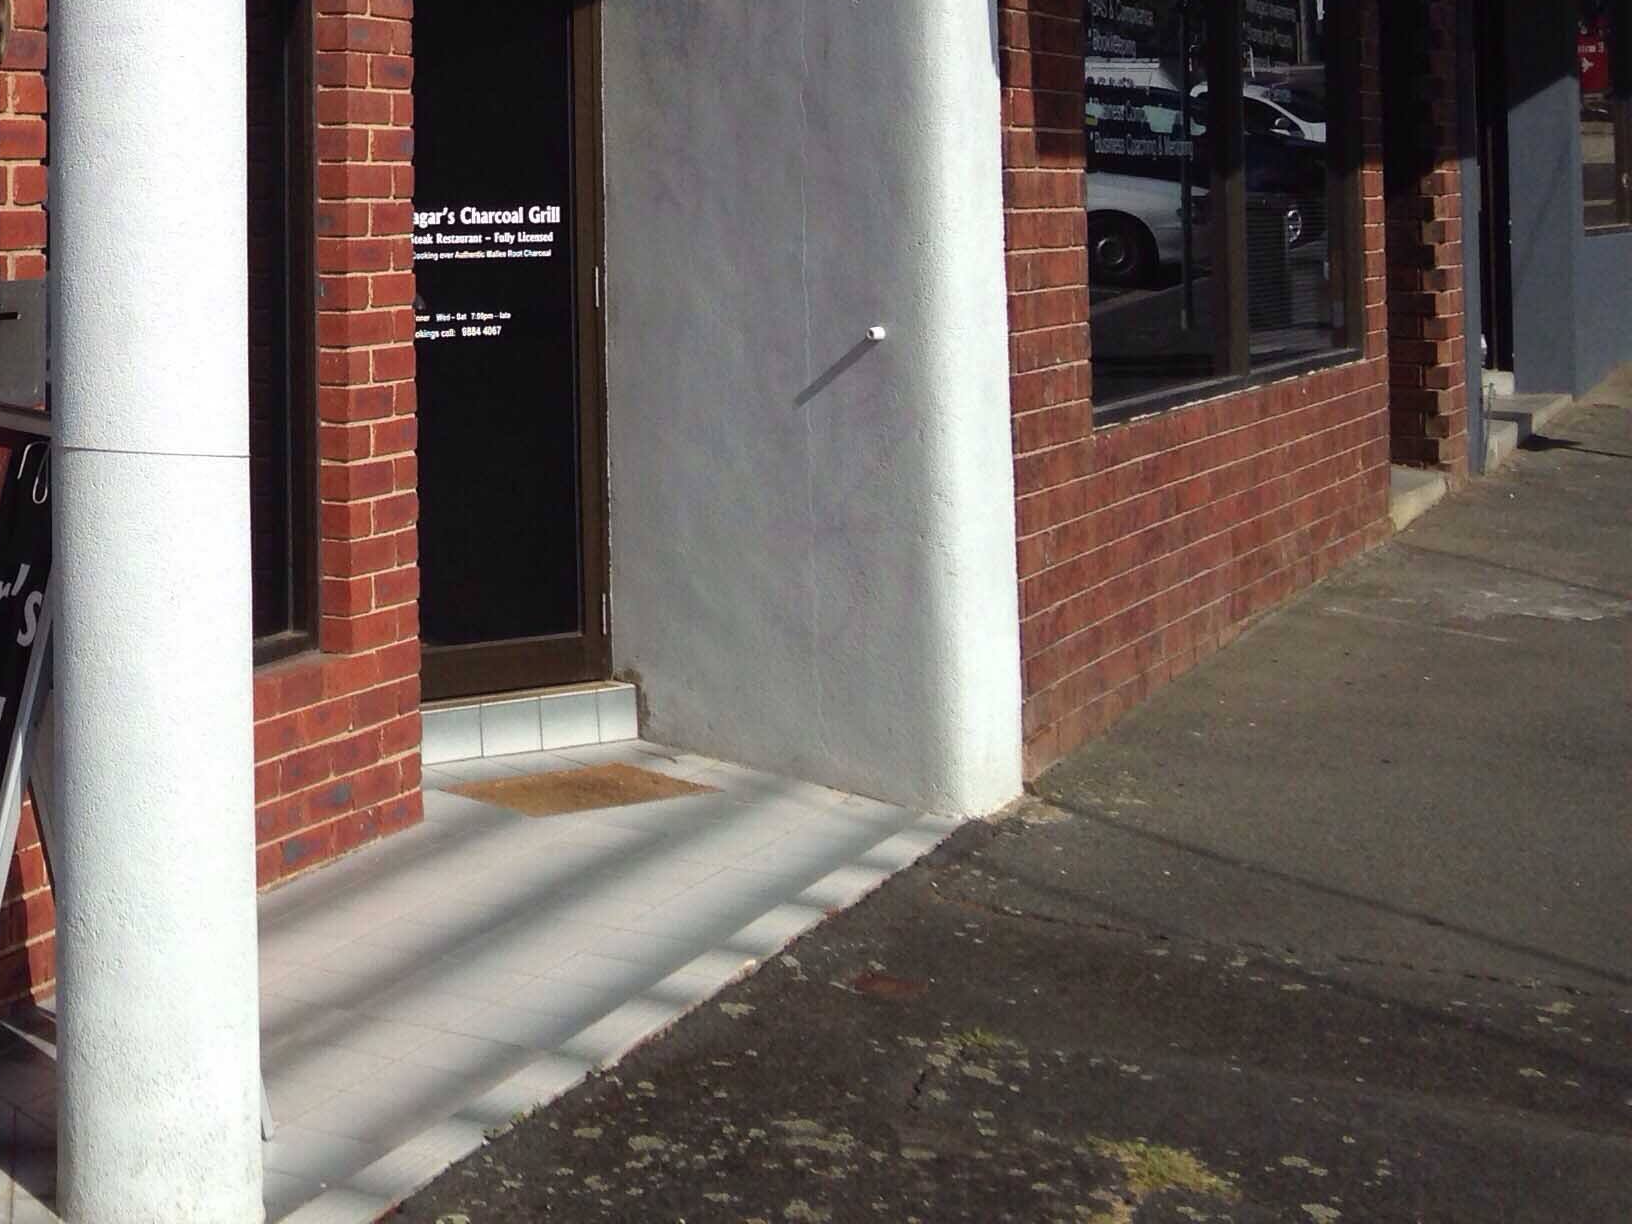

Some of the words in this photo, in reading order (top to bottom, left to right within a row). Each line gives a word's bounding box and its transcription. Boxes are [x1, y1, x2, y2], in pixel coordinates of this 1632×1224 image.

[413, 207, 455, 228] agar's
[460, 206, 524, 225] Charcoal
[528, 205, 560, 223] Grill
[436, 232, 483, 244] Restaurant
[494, 232, 516, 245] Fully
[517, 232, 554, 243] Licensed
[523, 249, 552, 257] Charcoal
[461, 326, 481, 337] 9884
[482, 325, 502, 336] 4067
